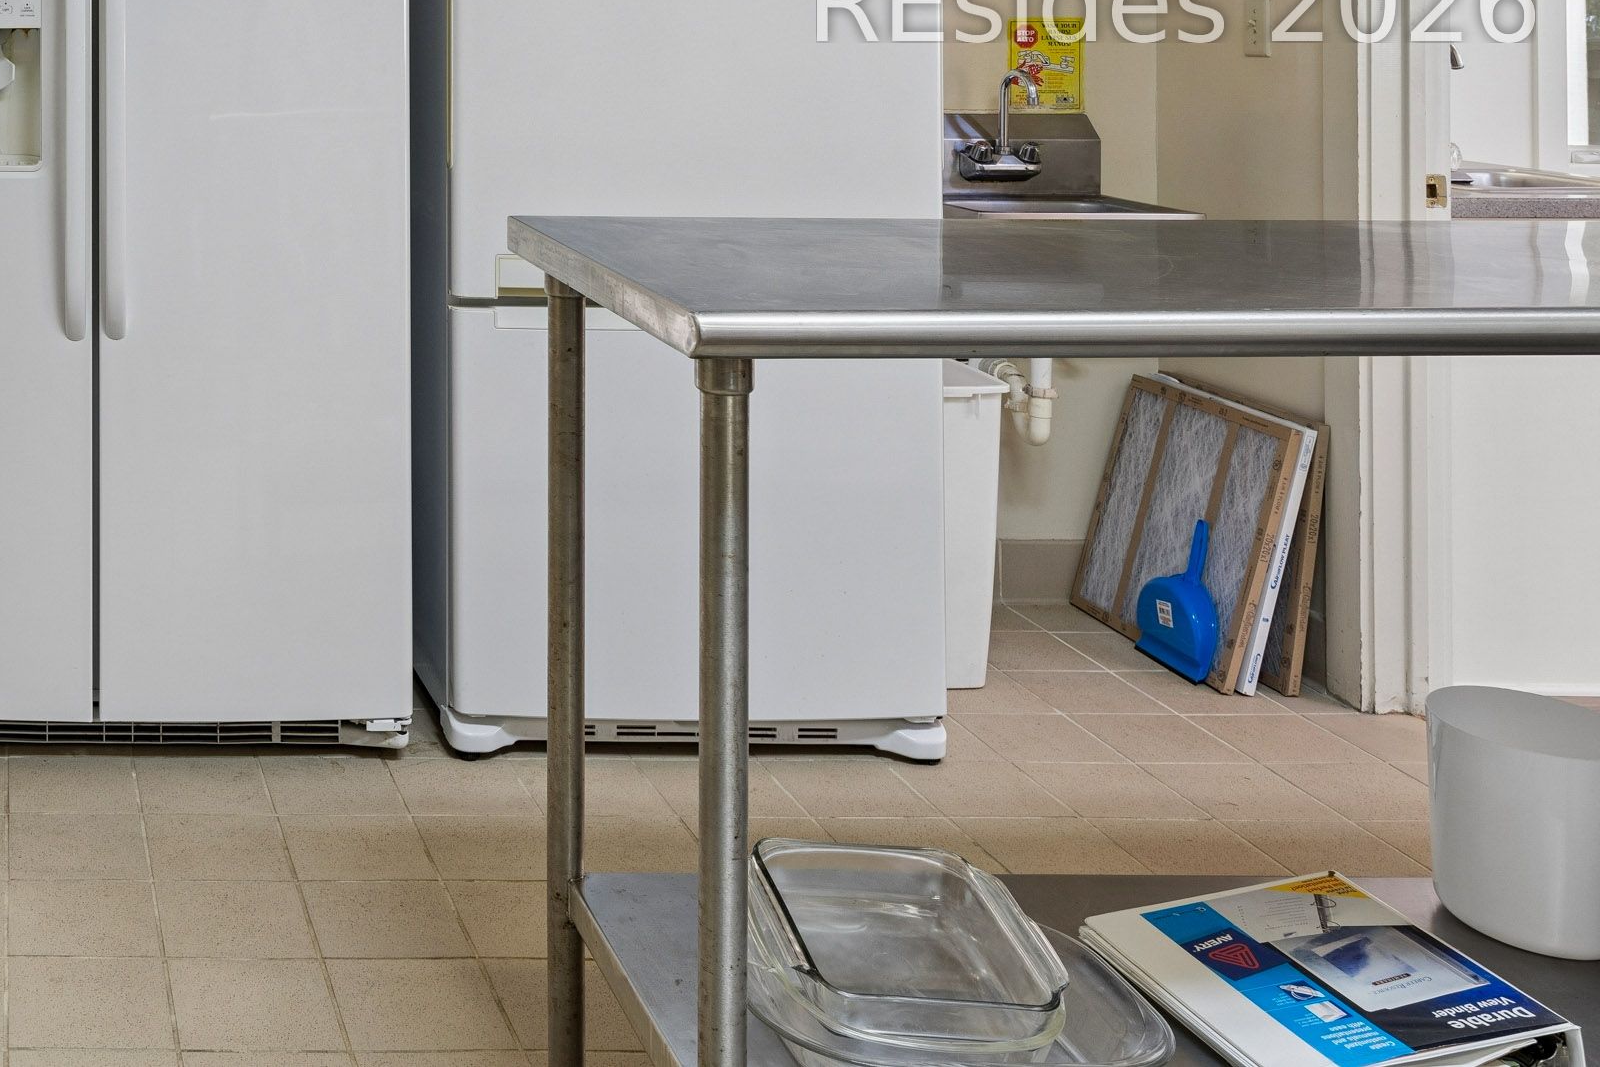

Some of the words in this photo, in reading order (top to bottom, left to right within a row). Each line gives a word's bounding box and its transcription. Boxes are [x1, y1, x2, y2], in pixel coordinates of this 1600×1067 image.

[1194, 933, 1234, 953] AVERY
[1432, 1002, 1479, 1020] Binder
[1478, 996, 1516, 1010] View
[1447, 1006, 1537, 1030] Durable
